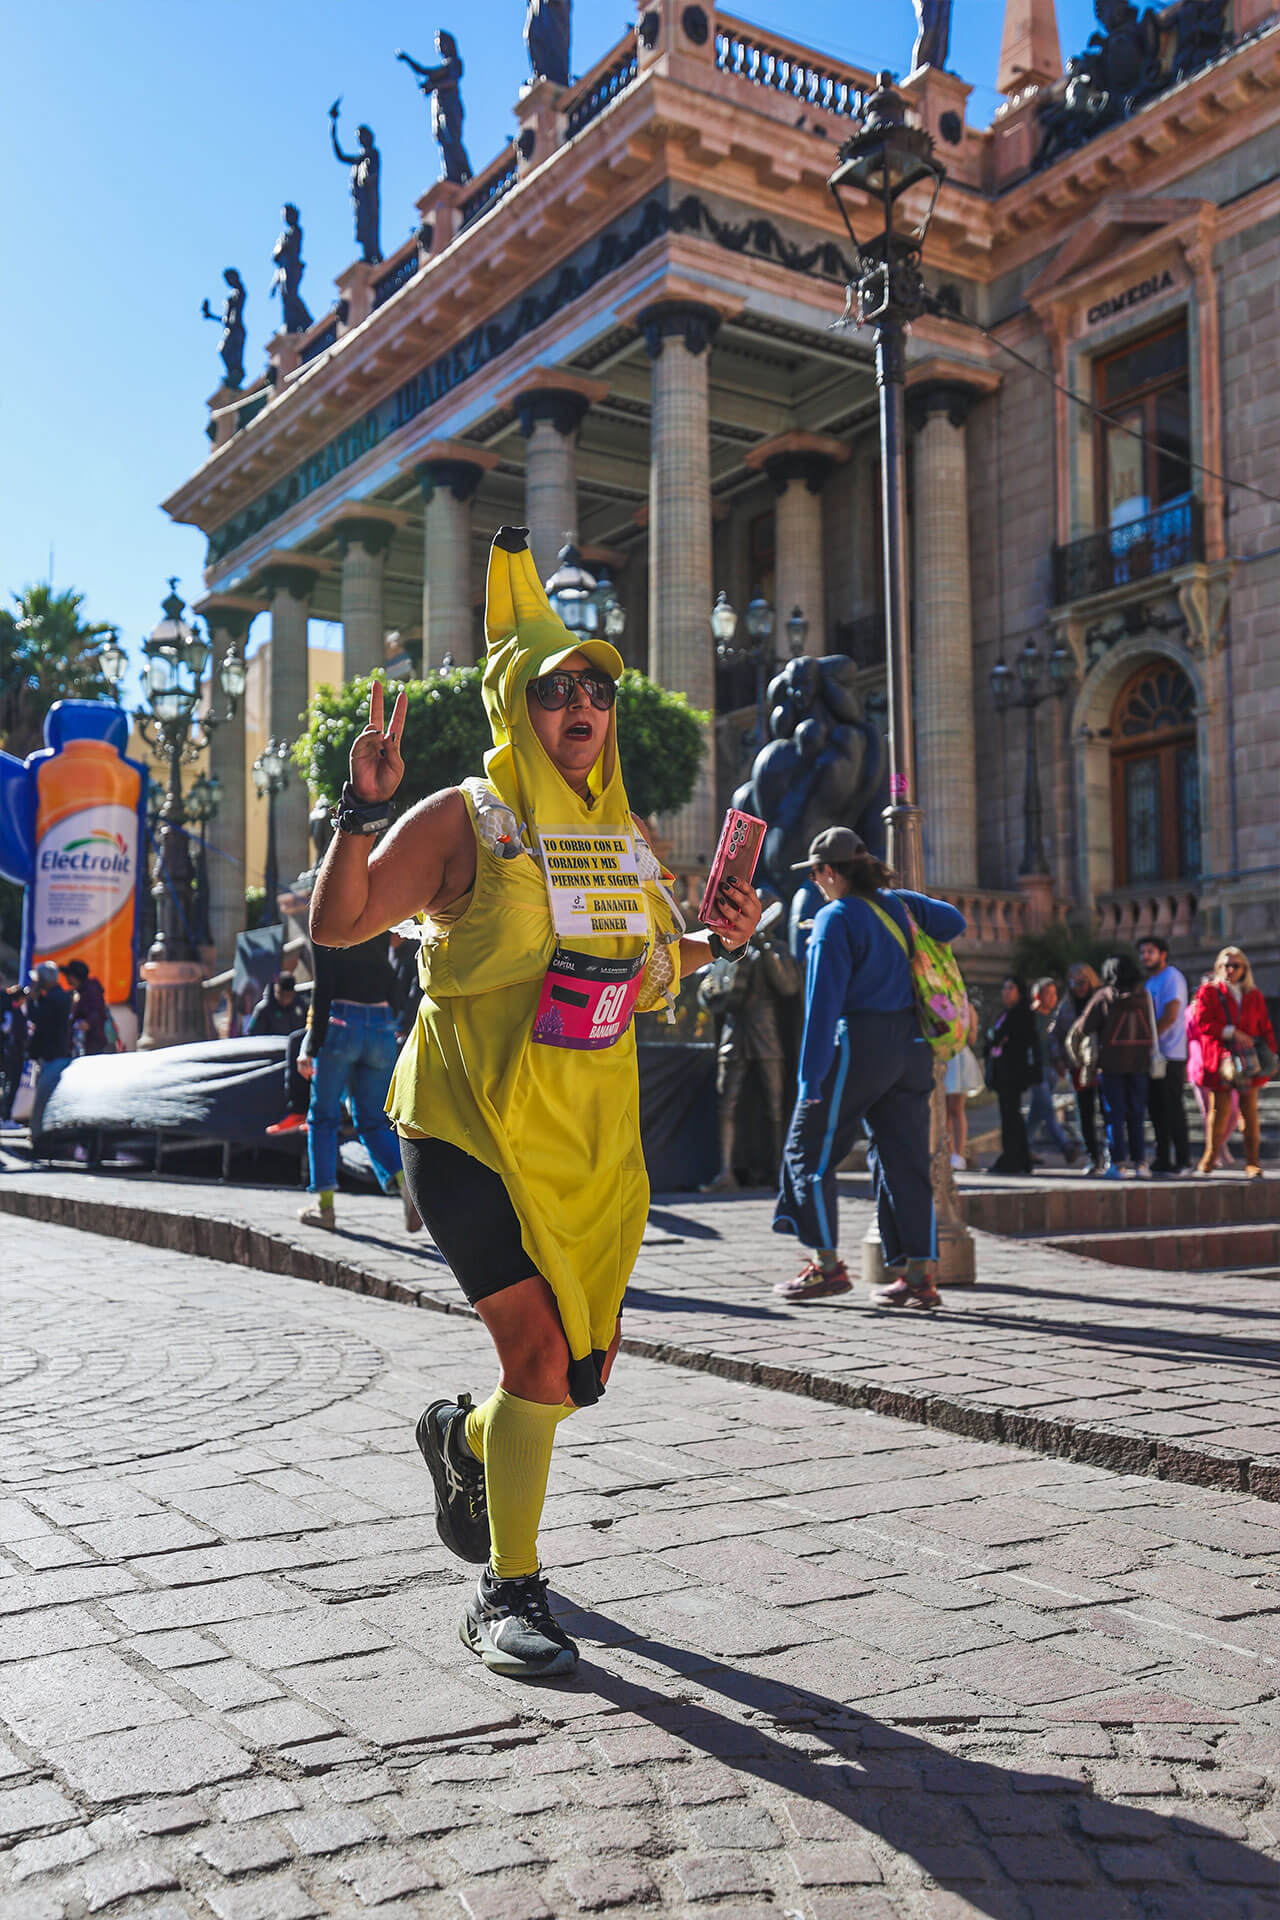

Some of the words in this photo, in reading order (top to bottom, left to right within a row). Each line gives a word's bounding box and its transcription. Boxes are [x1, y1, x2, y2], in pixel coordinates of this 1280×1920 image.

[1087, 269, 1174, 324] COMEDIA
[299, 412, 377, 500] TEATRO
[543, 839, 557, 851] YO
[559, 839, 592, 852] CORRO
[593, 840, 612, 852] CON
[613, 840, 625, 852] EL
[41, 850, 130, 873] Electrolit
[547, 857, 590, 869] CORAZON
[591, 857, 599, 869] Y
[600, 857, 617, 869] MIS
[551, 874, 591, 887] PIERNAS
[592, 874, 607, 887] ME
[607, 874, 640, 887] SIGUEN
[593, 899, 638, 912] BANANITA
[591, 918, 628, 930] RUNNER
[552, 959, 576, 971] CAPITAL
[591, 983, 628, 1025] 60
